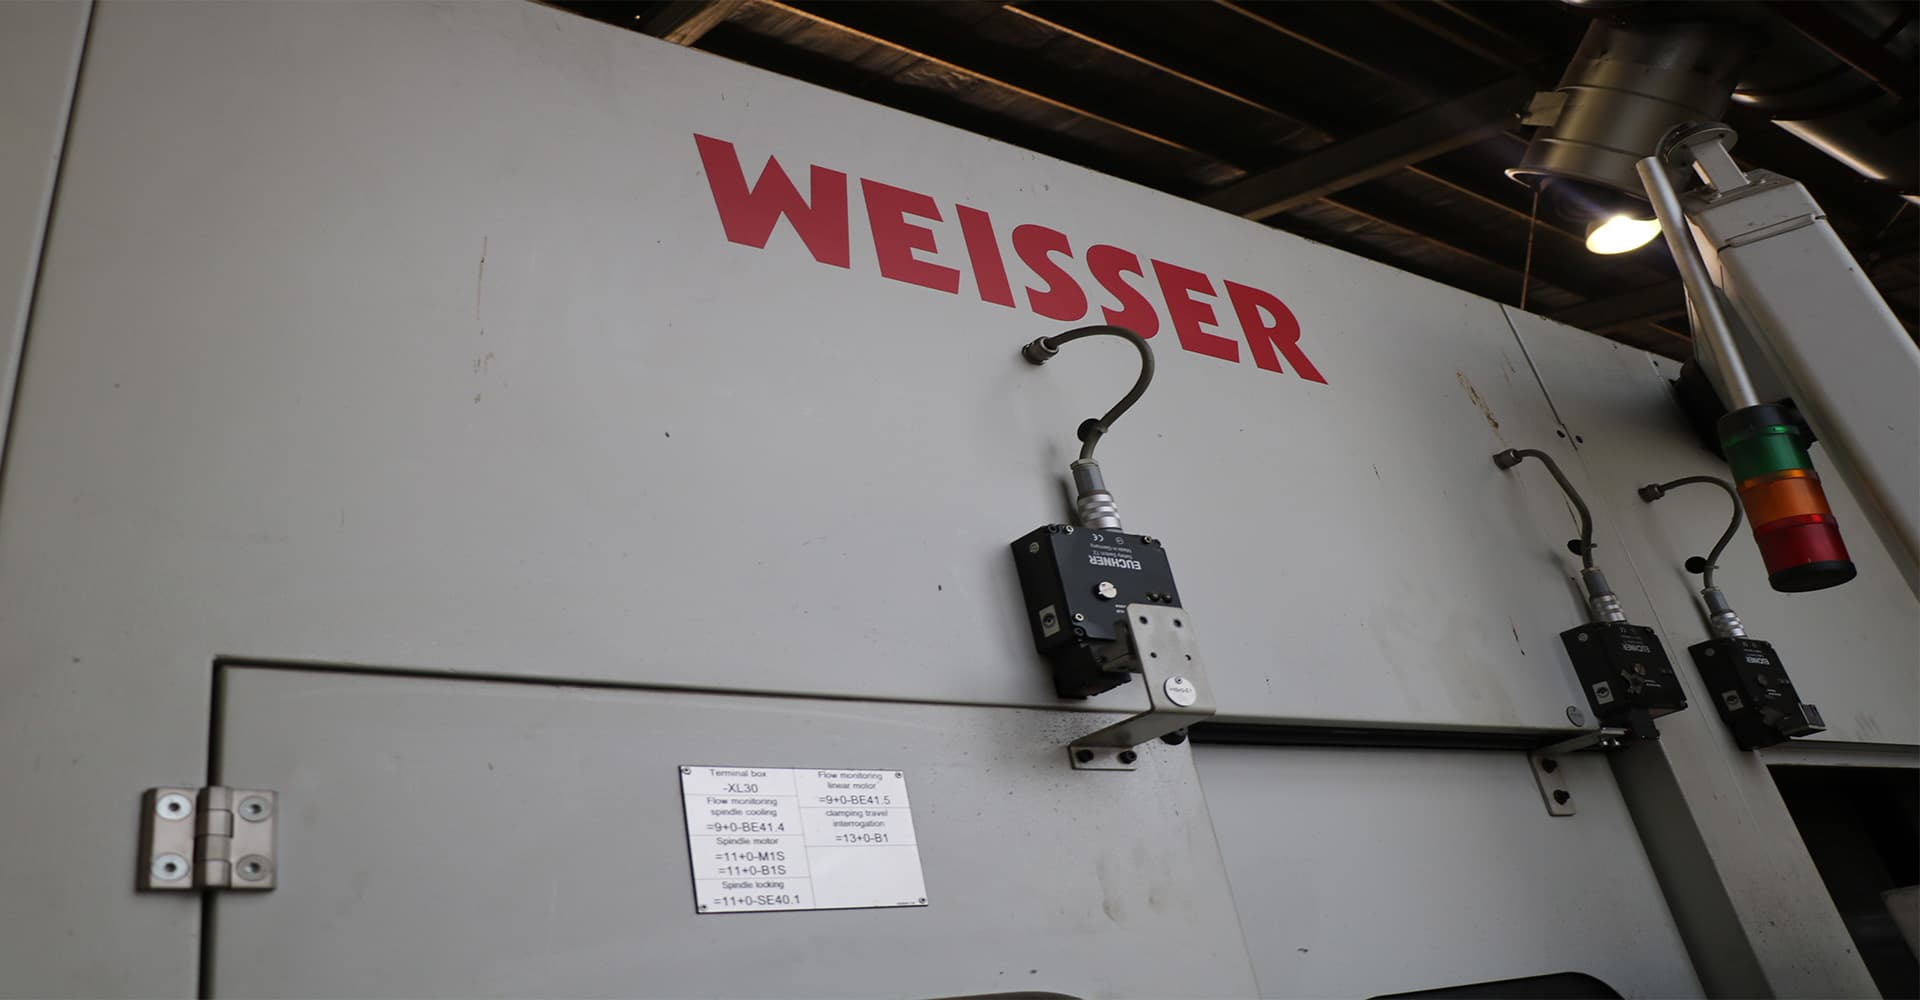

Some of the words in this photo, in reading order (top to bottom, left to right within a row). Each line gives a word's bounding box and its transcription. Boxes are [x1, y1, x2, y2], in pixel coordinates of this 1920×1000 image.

[693, 133, 1328, 384] WEISSER
[1088, 554, 1142, 570] EUCHNER
[710, 768, 748, 778] Terminal
[751, 769, 767, 778] box
[818, 770, 838, 779] Flow
[840, 771, 883, 782] monitoring
[723, 783, 759, 794] -XL30
[828, 781, 850, 790] linear
[853, 782, 876, 790] motor
[707, 796, 728, 805] Flow
[731, 797, 778, 808] monitoring
[818, 795, 891, 806] =9+0-BE41.5
[711, 807, 743, 818] spindle
[745, 808, 778, 818] cooling
[825, 809, 863, 819] clamping
[865, 809, 888, 818] travel
[706, 822, 785, 833] =9+0-BE41.4
[833, 819, 885, 829] interrogation
[716, 836, 751, 847] Spindle
[754, 838, 779, 846] motor
[835, 832, 889, 844] =13+0-B1
[715, 850, 785, 862] =11+0-M1S
[718, 865, 787, 876] =11+0-B1S
[722, 880, 753, 890] Spindle
[755, 880, 785, 890] locking
[713, 894, 801, 906] =11+0-SE40.1
